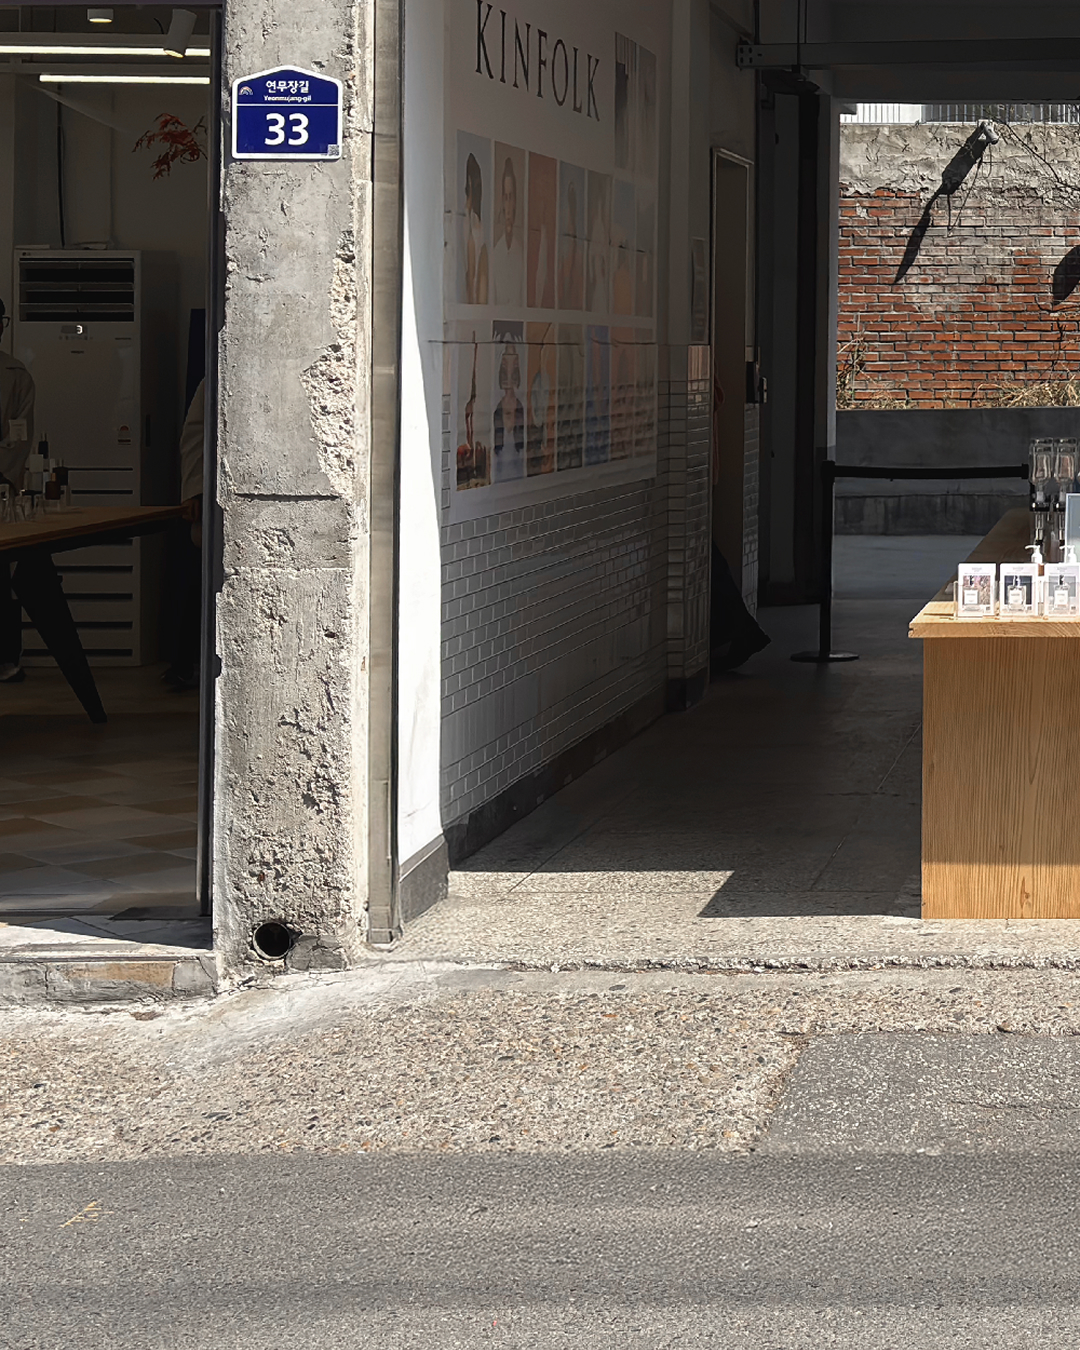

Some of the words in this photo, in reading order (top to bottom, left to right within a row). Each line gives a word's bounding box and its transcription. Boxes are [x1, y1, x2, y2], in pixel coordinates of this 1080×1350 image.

[265, 80, 310, 94] 연무장길
[263, 95, 312, 103] Yeonmujang-gil
[264, 112, 309, 146] 33
